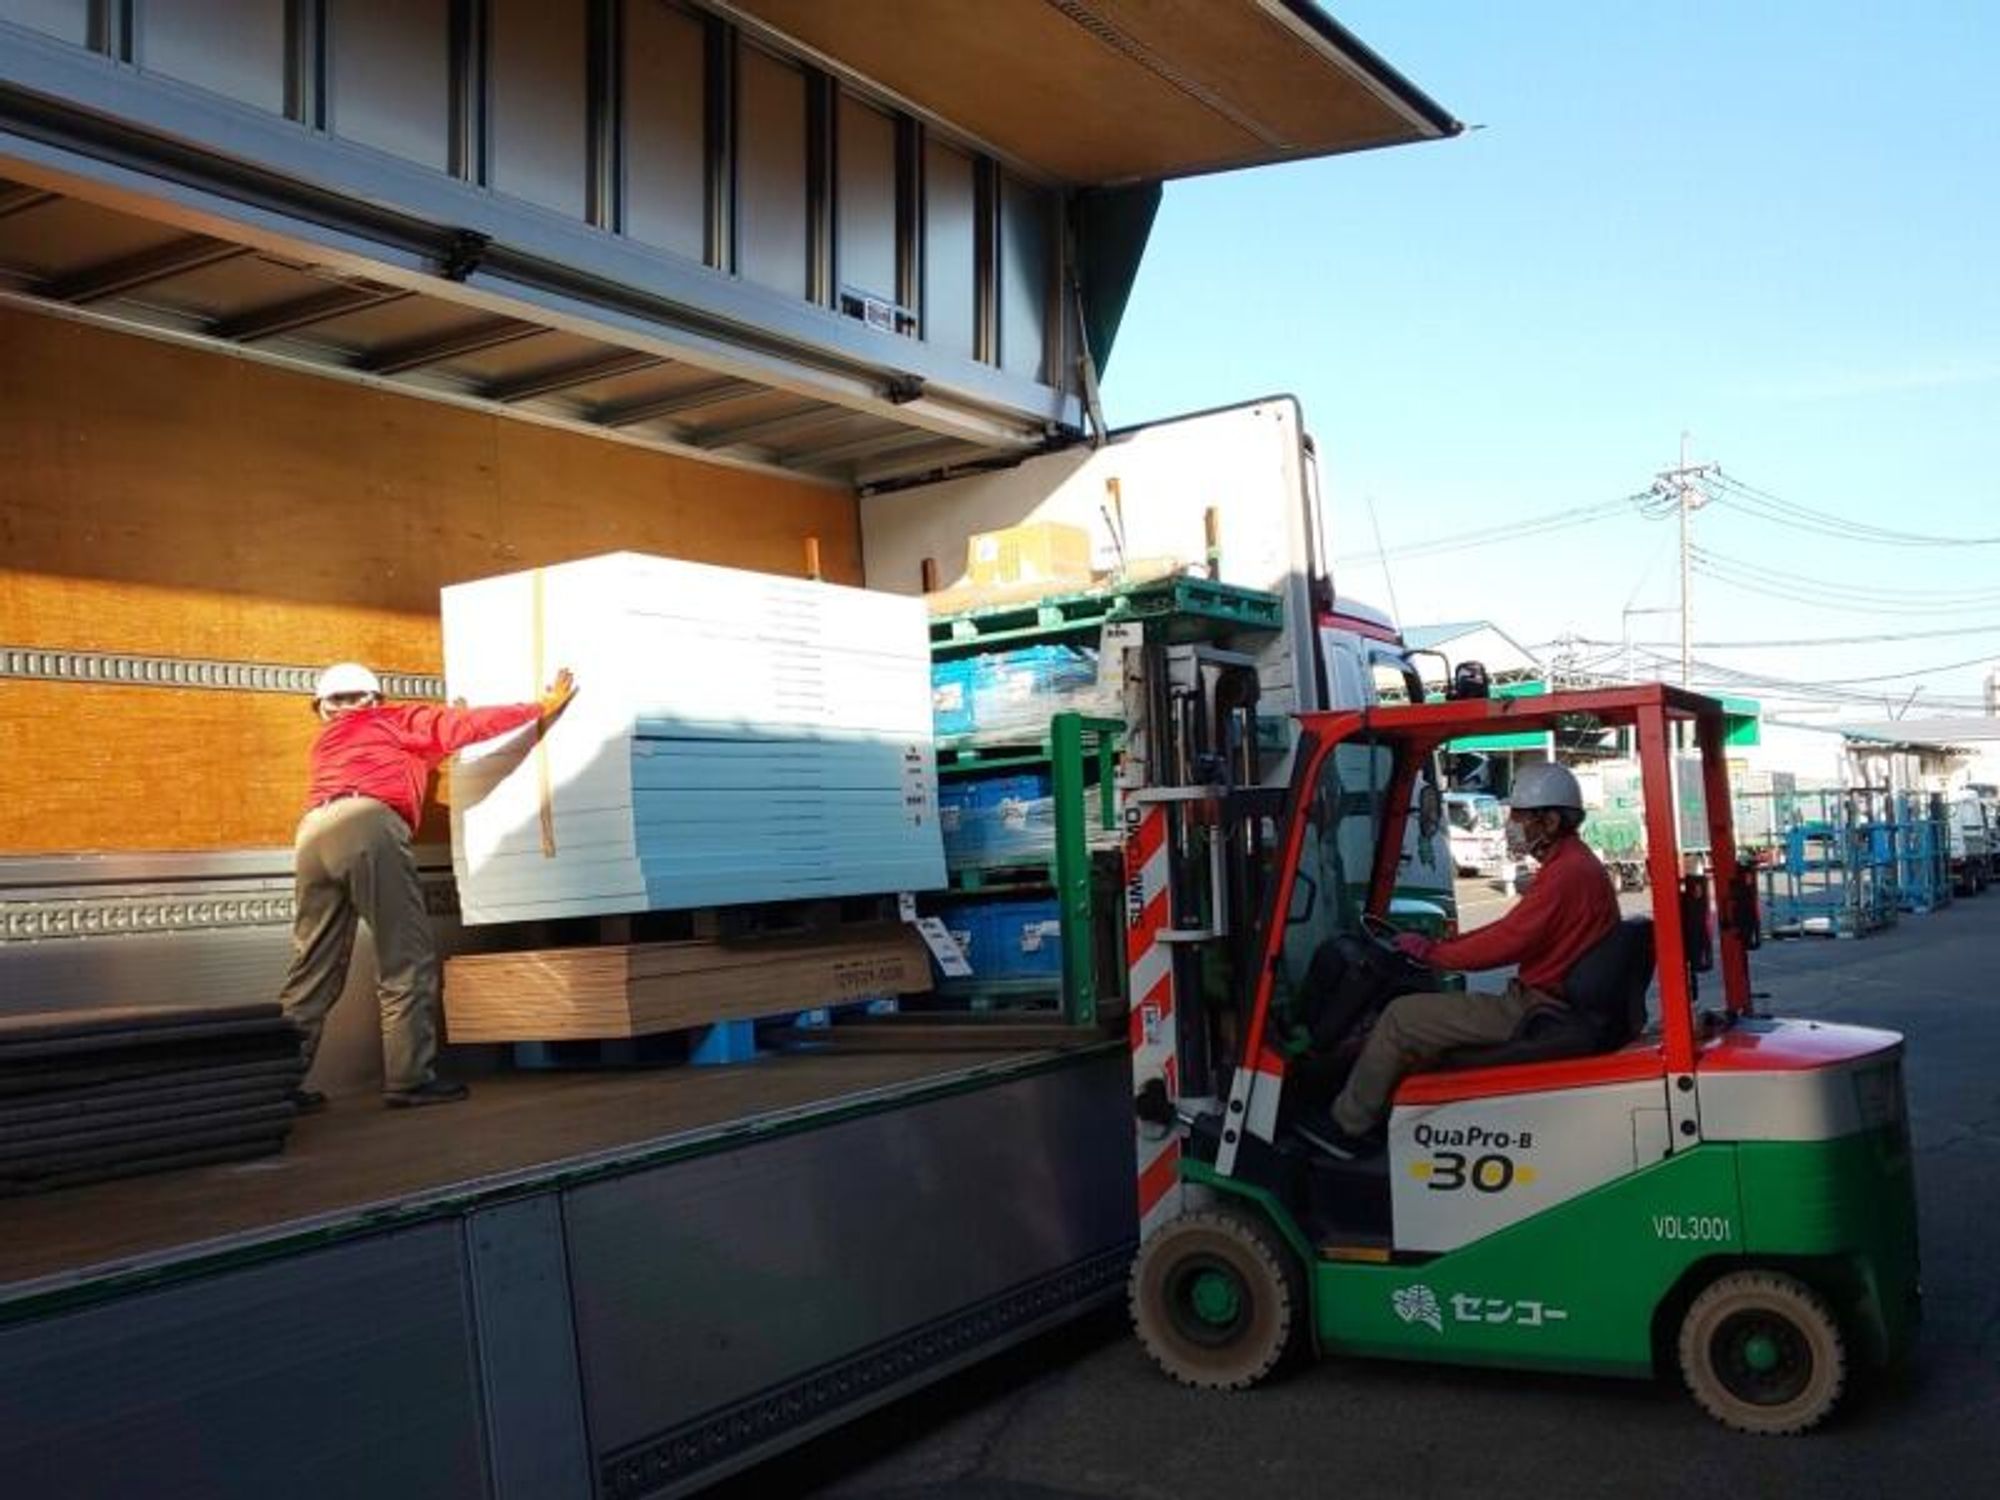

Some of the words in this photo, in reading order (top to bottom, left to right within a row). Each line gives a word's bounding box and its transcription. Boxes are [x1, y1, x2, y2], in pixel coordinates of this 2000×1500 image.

[1414, 1124, 1532, 1149] QuaPro-B
[1427, 1152, 1514, 1193] 30
[1450, 1293, 1568, 1326] センコー
